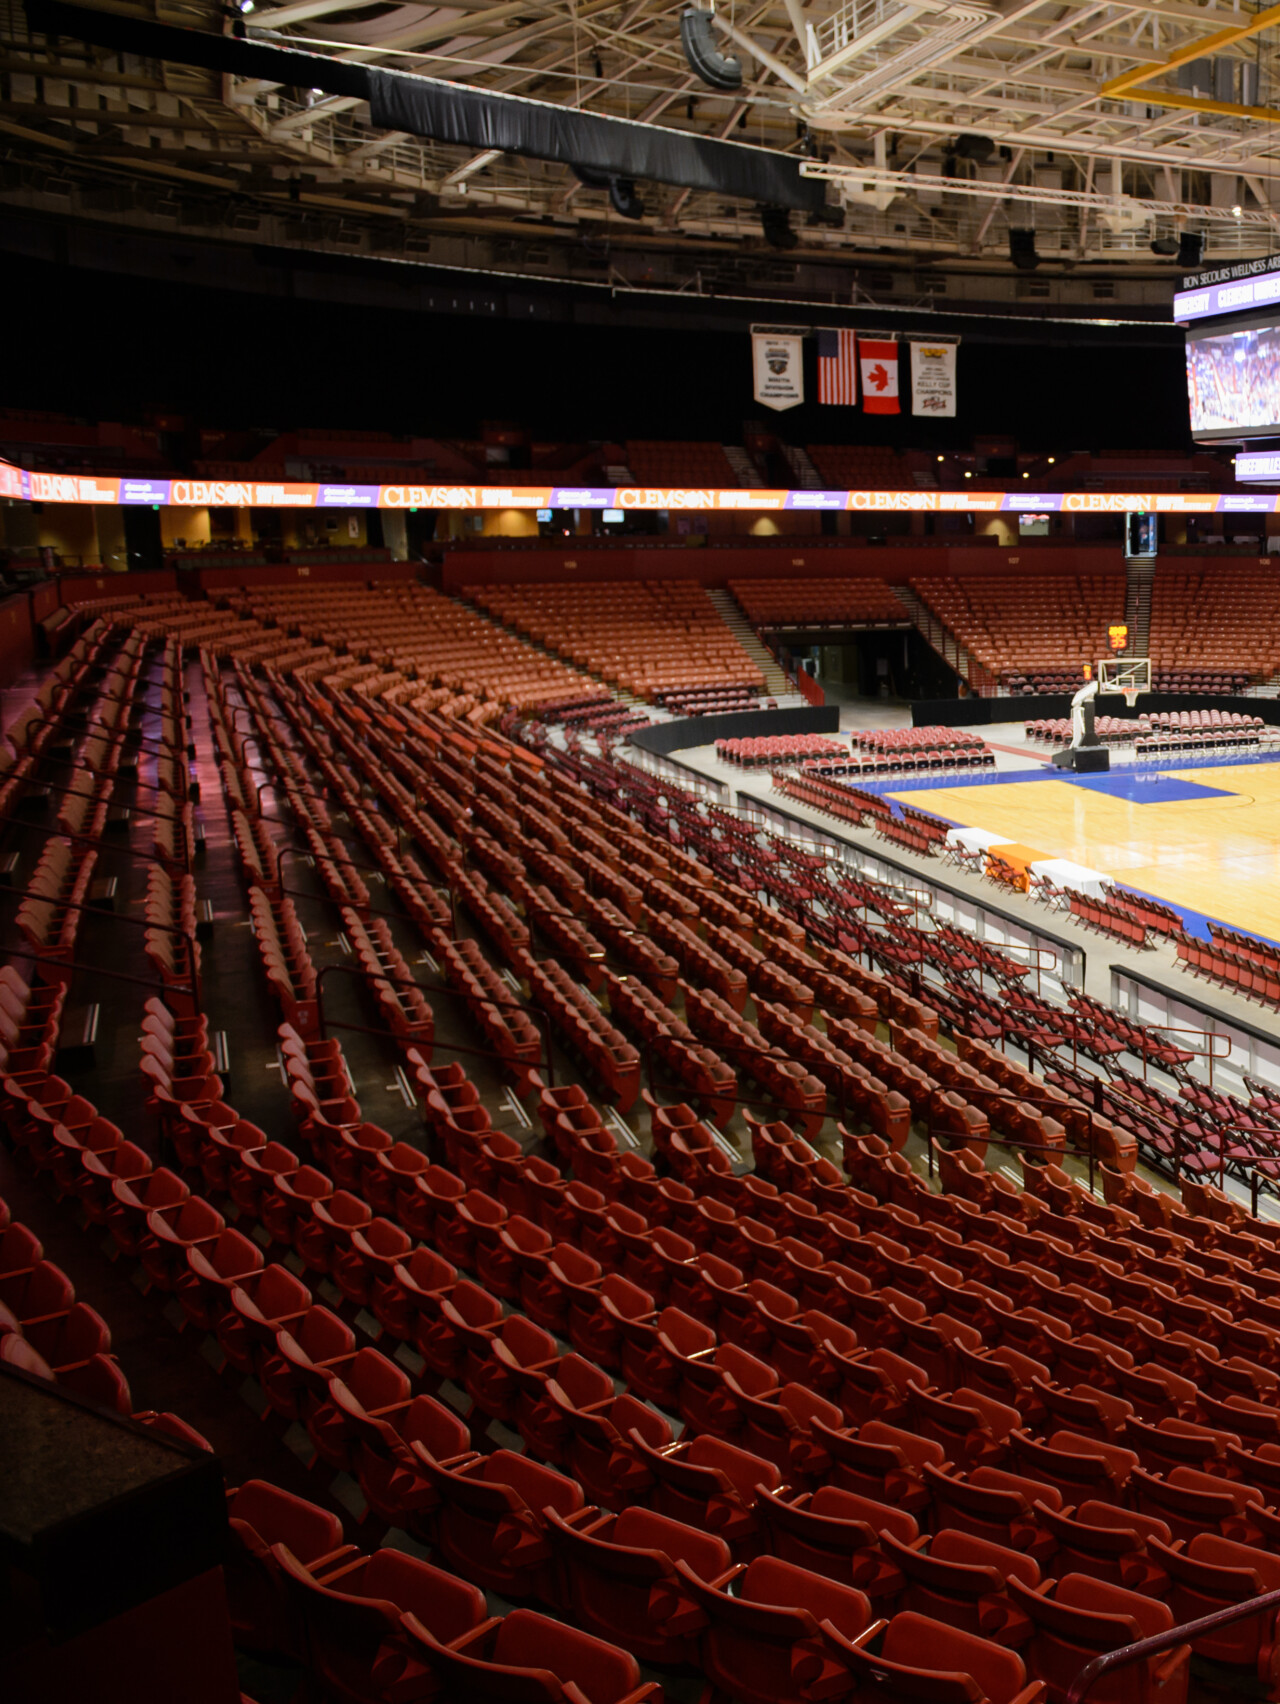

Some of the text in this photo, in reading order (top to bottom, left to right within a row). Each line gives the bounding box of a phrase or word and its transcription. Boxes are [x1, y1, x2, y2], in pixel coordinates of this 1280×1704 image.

[1183, 275, 1199, 288] BON
[1200, 267, 1231, 286] SECOURS
[1231, 259, 1267, 278] WELLNESS
[1218, 284, 1254, 308] CLEMSON
[31, 474, 78, 501] CLEMSON
[173, 482, 252, 504] CLEMSON
[384, 486, 476, 506] CLEMSON
[620, 490, 714, 508] CLEMSON
[852, 492, 936, 510] CLEMSON
[1066, 495, 1152, 511] CLEMSON
[1008, 557, 1020, 565] 107
